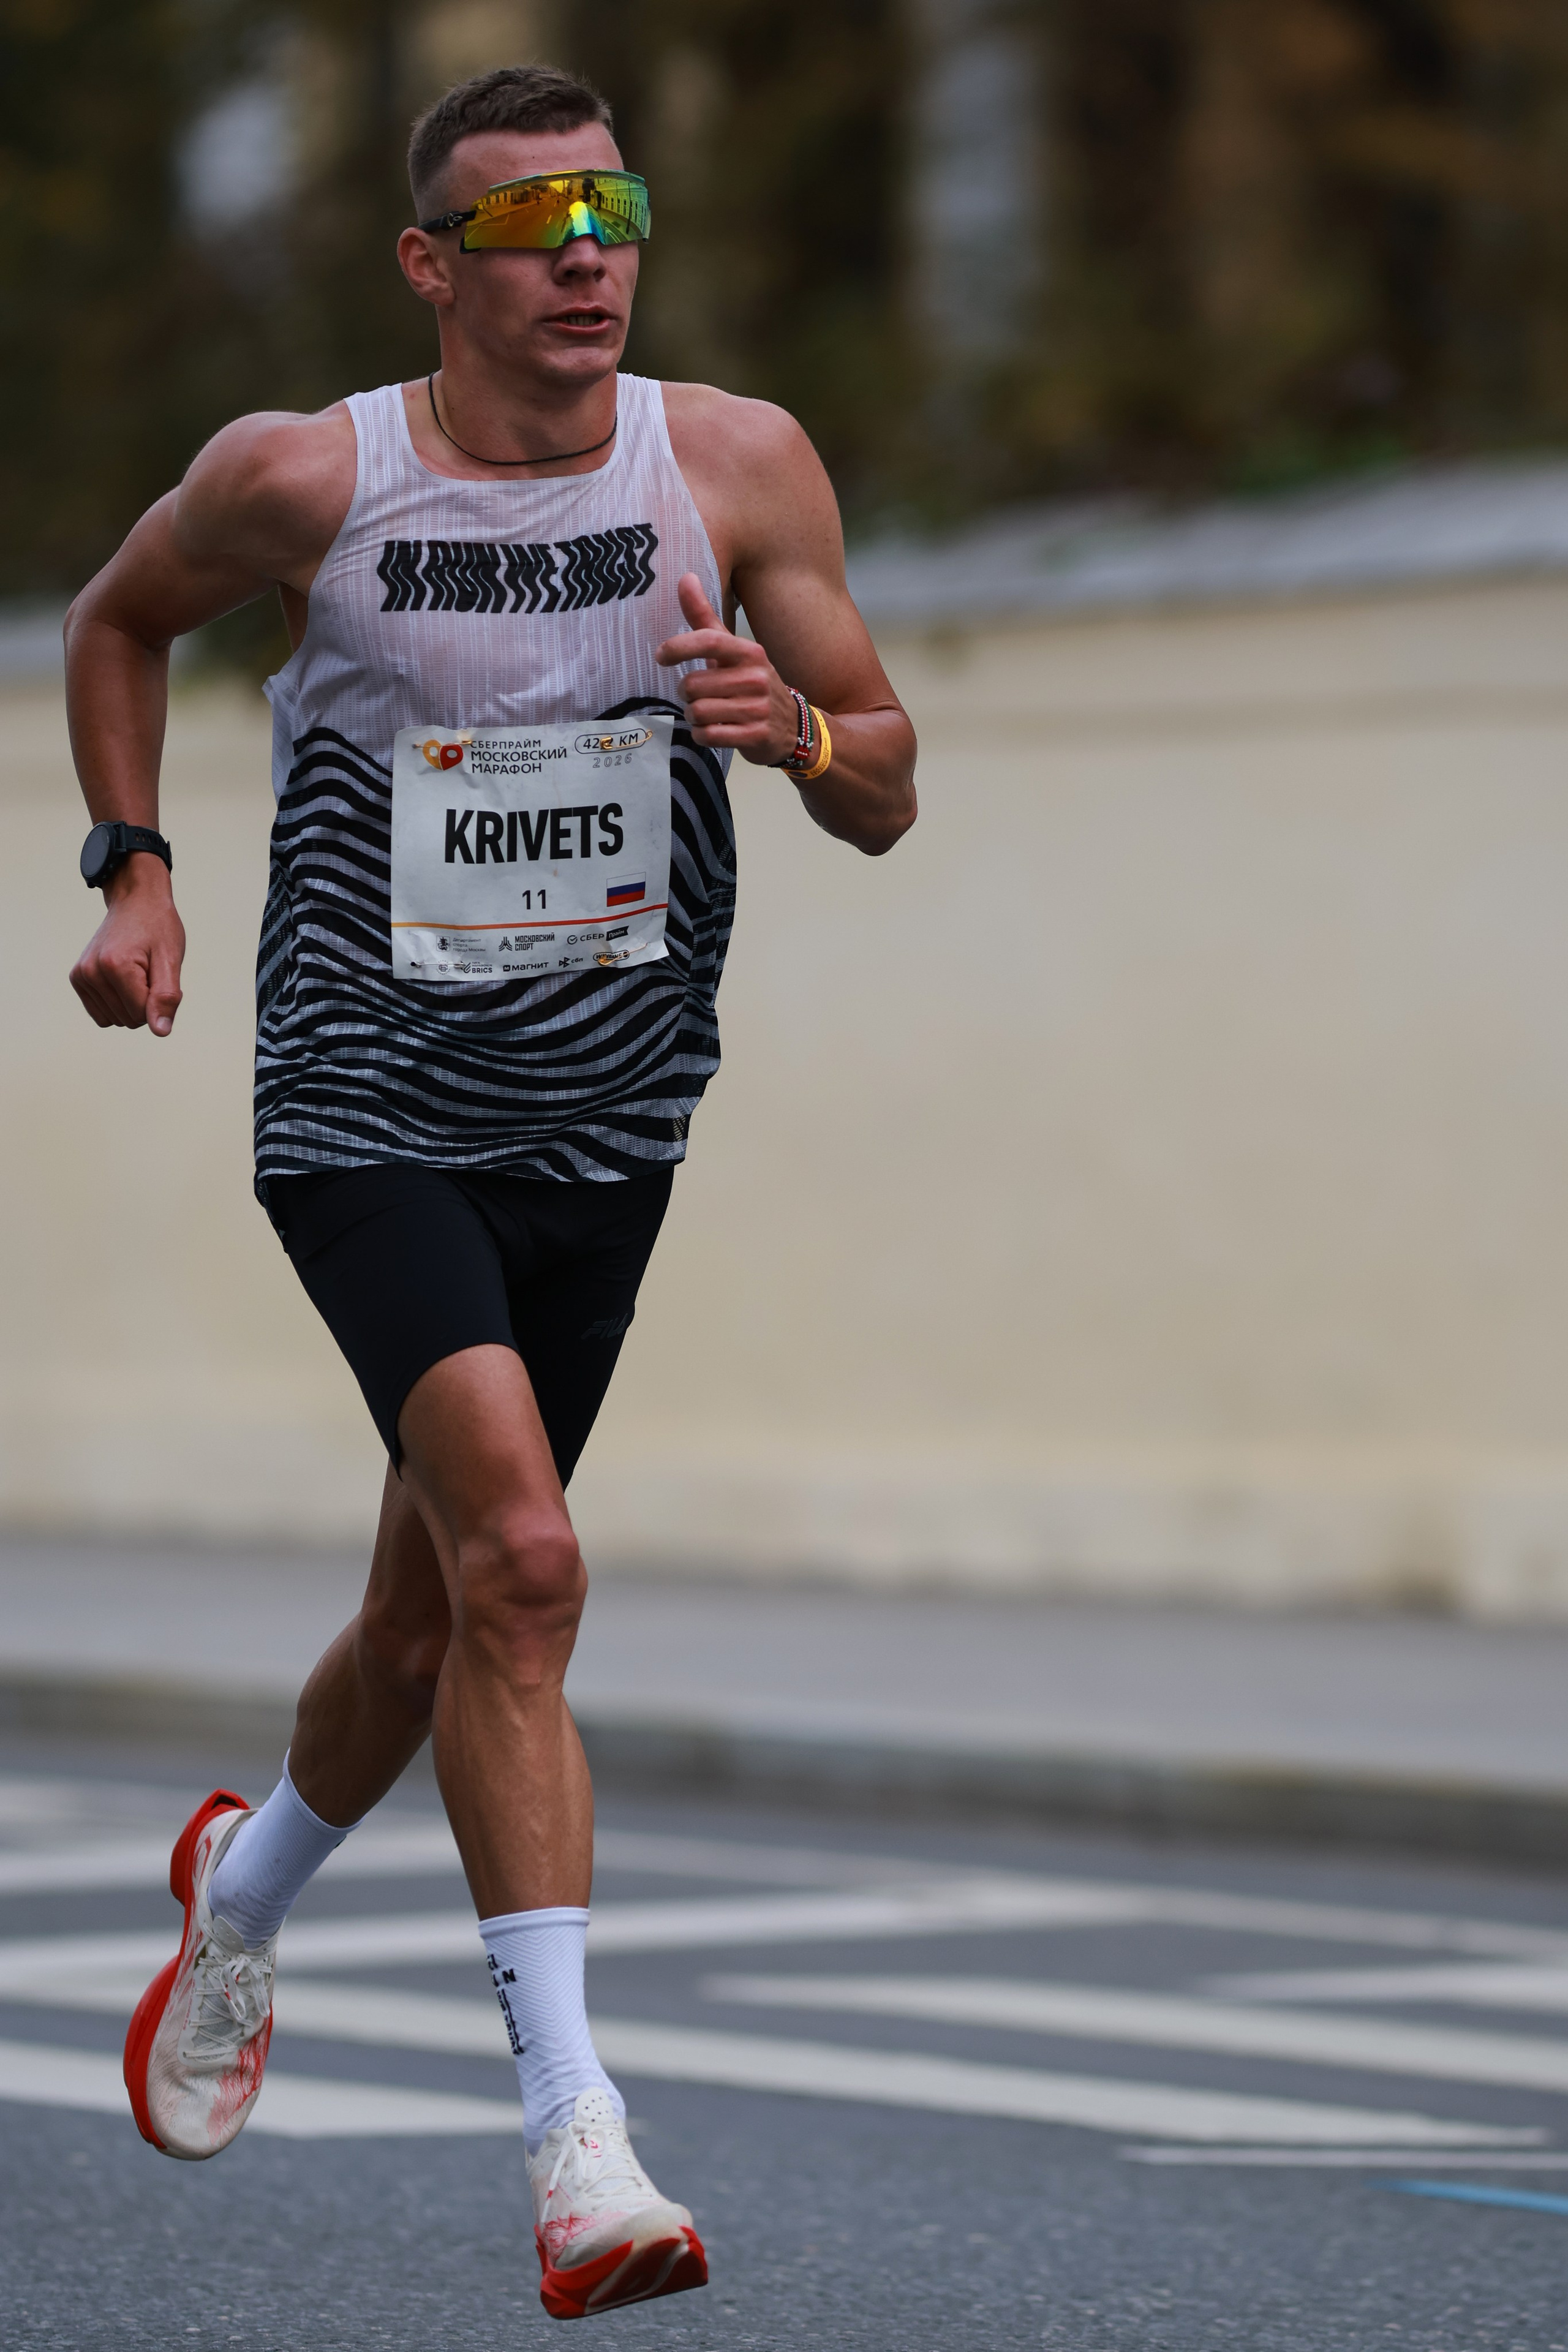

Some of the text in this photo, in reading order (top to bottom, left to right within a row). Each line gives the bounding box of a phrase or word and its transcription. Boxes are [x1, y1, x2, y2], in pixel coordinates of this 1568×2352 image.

[377, 522, 658, 614] IN RUN WE TRUST
[470, 739, 541, 749] СБЕРПРАЙМ
[471, 747, 567, 763] МОСКОВСКИЙ
[592, 753, 632, 768] 2026
[472, 763, 541, 774] МАРАФОН
[445, 802, 624, 864] KRIVETS
[522, 889, 546, 910] 11
[515, 932, 555, 943] МОСКОВСКИЙ
